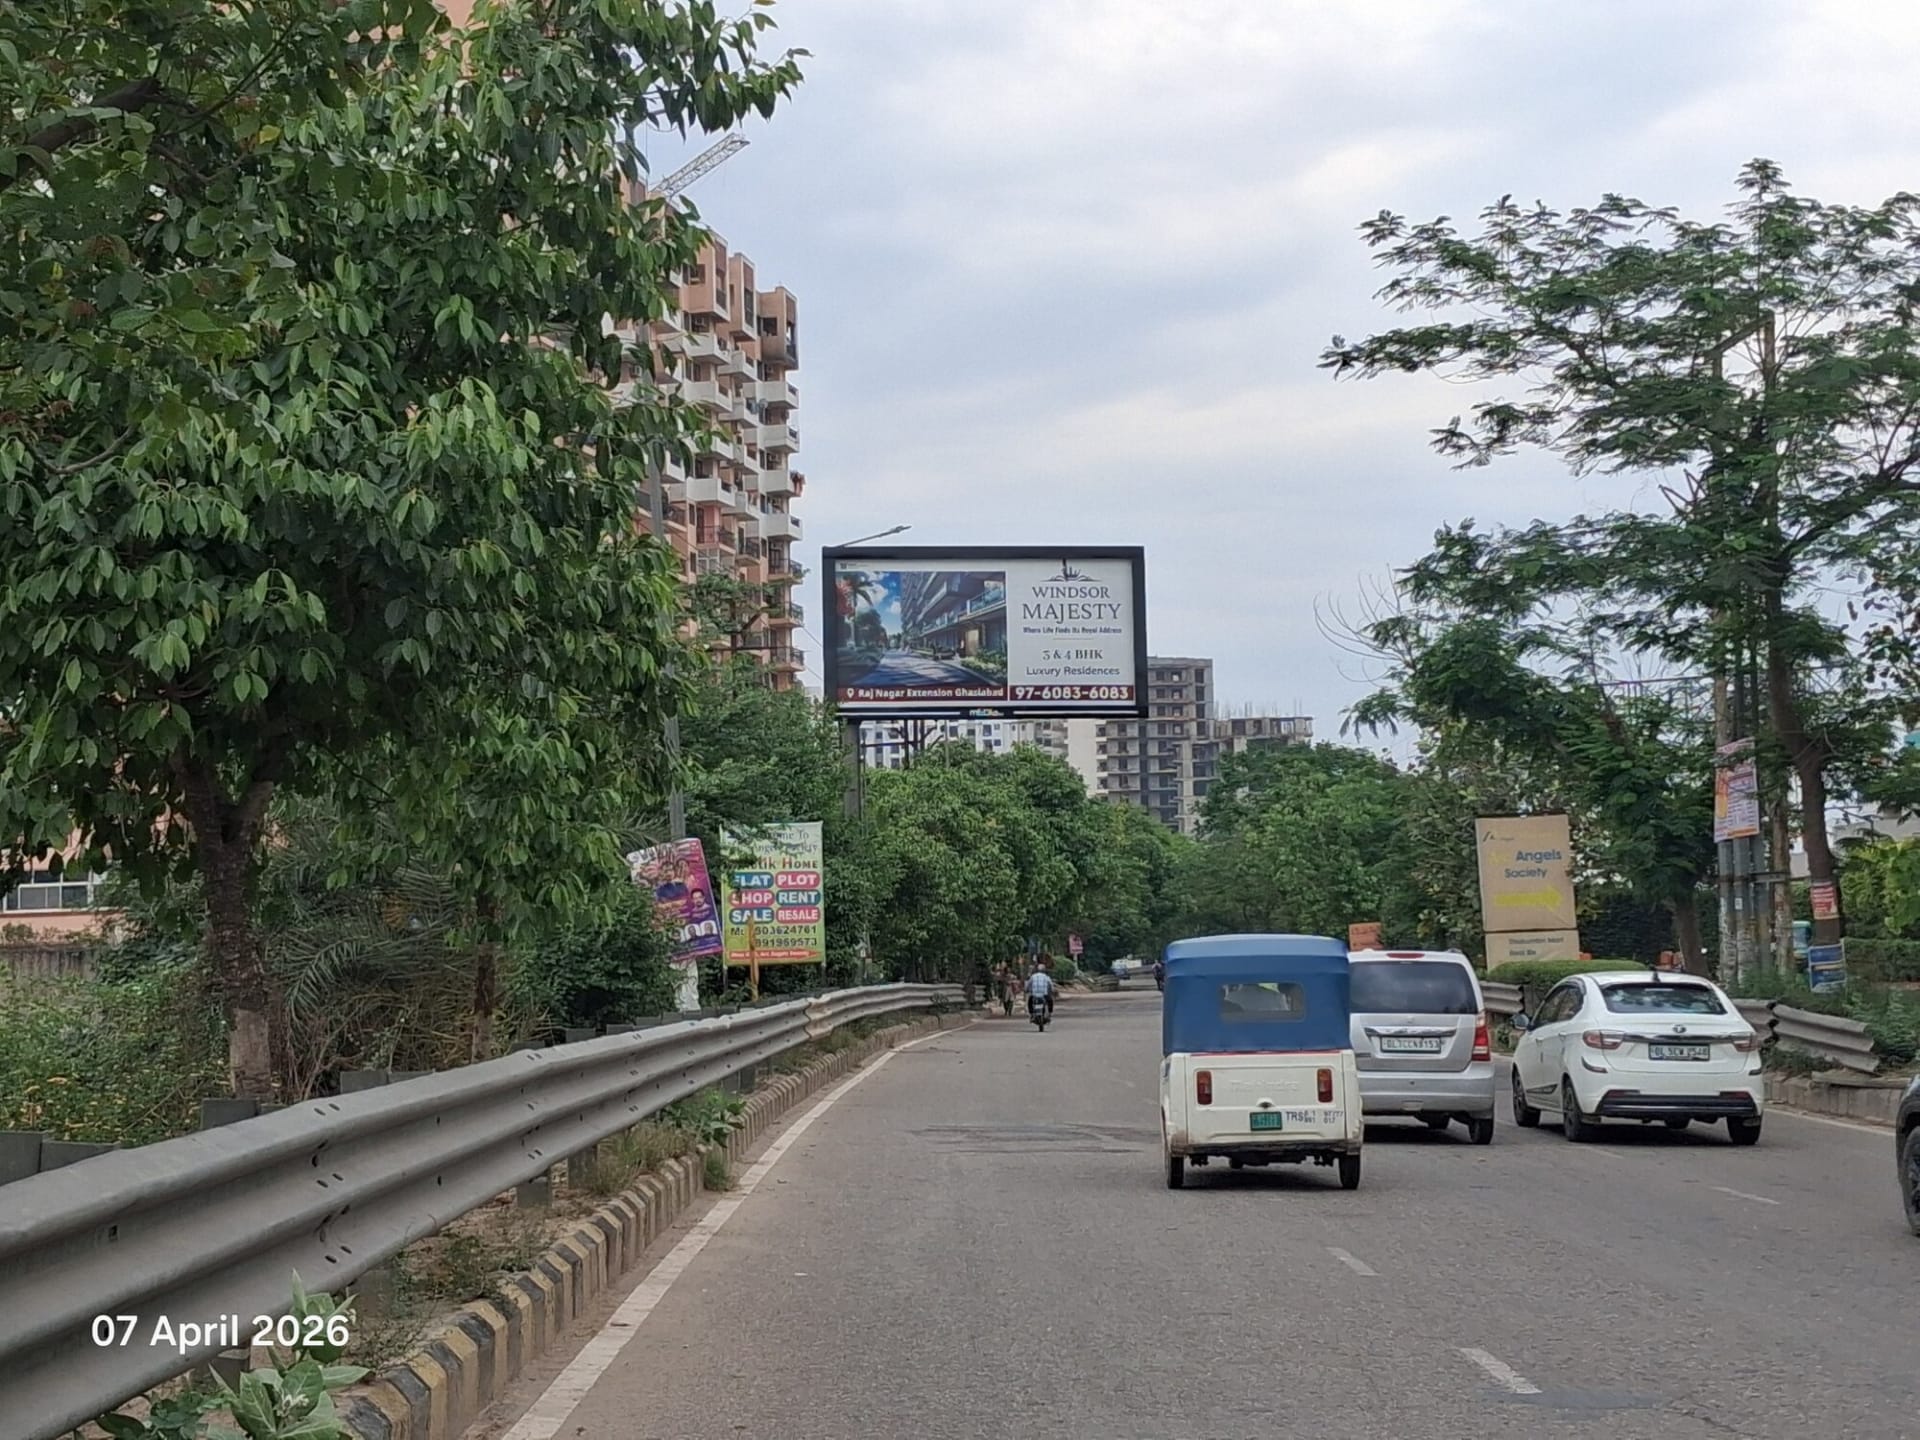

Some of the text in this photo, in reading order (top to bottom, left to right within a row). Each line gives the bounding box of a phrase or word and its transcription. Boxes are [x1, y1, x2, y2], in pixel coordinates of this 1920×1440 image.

[1032, 586, 1111, 599] WINDSOR
[1022, 603, 1122, 624] MAJESTY
[1075, 649, 1103, 660] BHK
[1026, 666, 1120, 677] Luxury Residences
[858, 687, 1004, 700] Raj Nagar Extension Ghaziabad
[1015, 686, 1129, 699] 97-6083-6083
[1516, 850, 1562, 863] Angels
[777, 873, 818, 886] PLOT
[1504, 867, 1547, 879] Society
[731, 891, 818, 905] SHOP RENT
[732, 909, 818, 923] SALE RESALE
